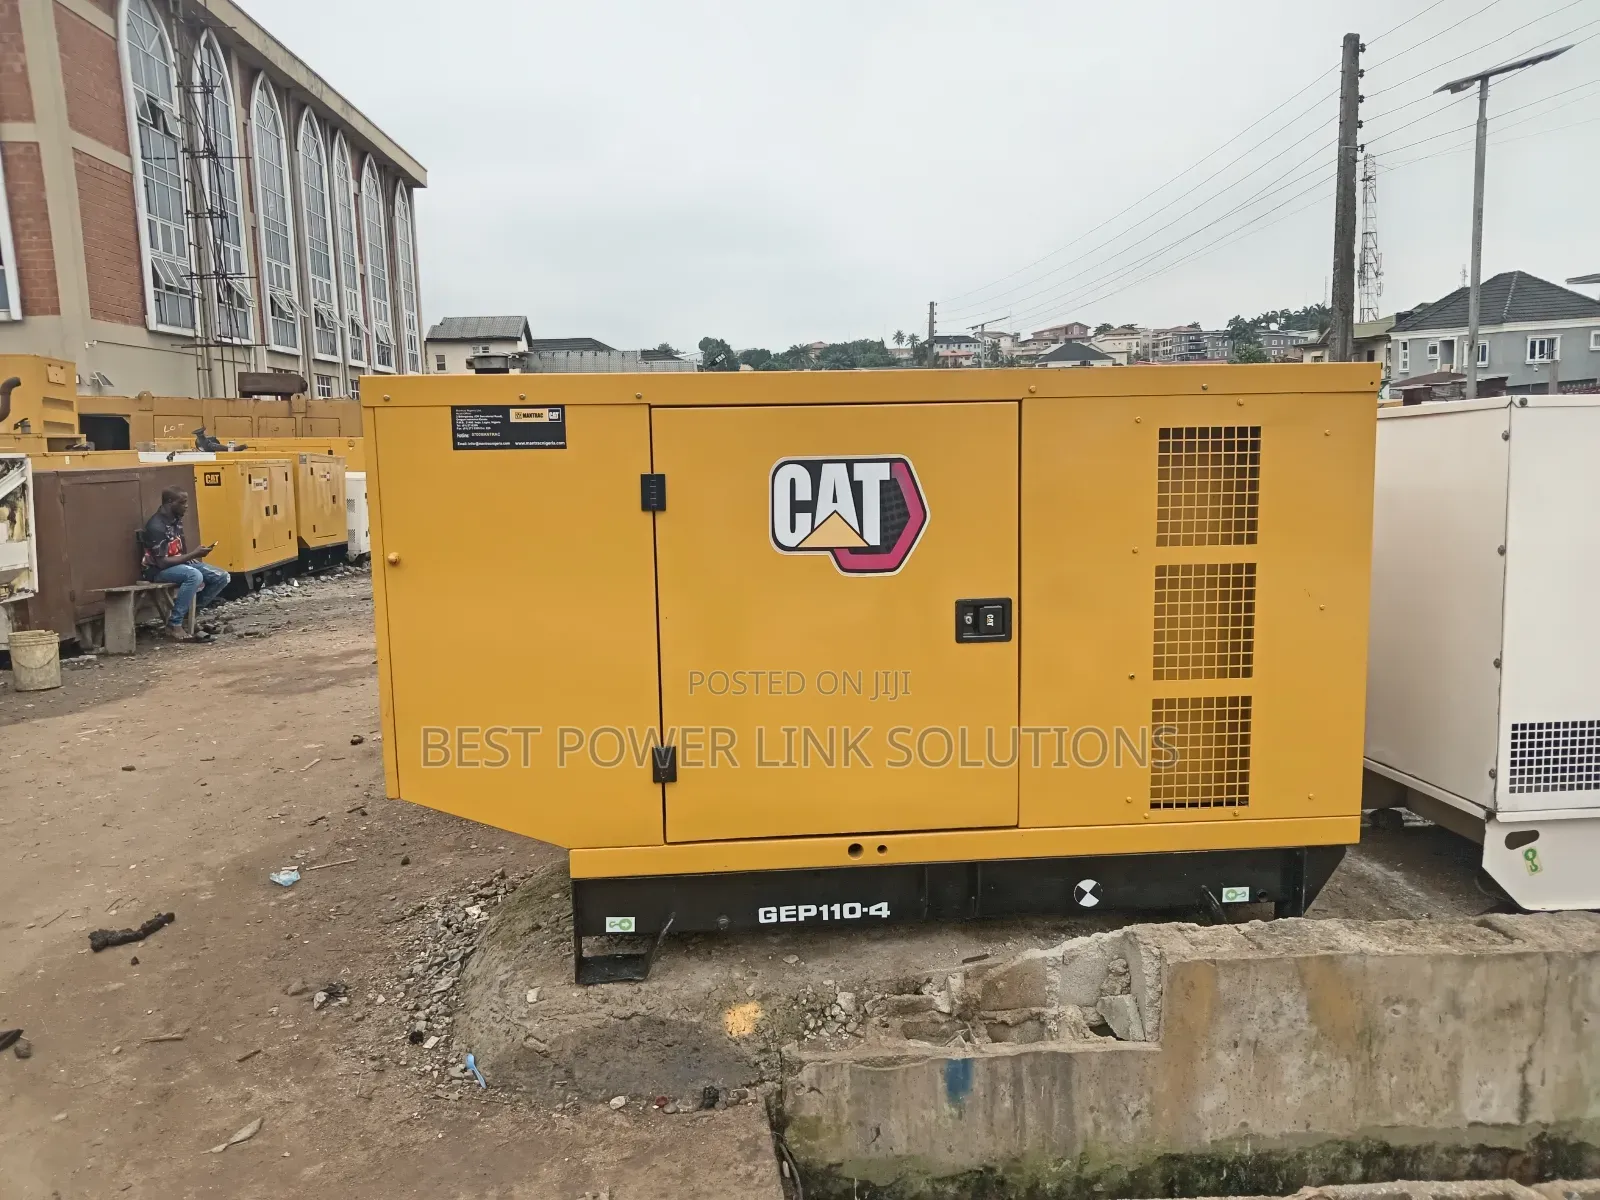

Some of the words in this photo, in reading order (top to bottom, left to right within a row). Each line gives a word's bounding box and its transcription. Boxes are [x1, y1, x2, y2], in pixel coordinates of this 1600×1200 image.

[548, 411, 560, 420] CAT
[205, 474, 220, 485] CAT
[773, 462, 891, 548] CAT
[986, 613, 995, 627] CAT
[758, 901, 891, 924] GEP110-4
